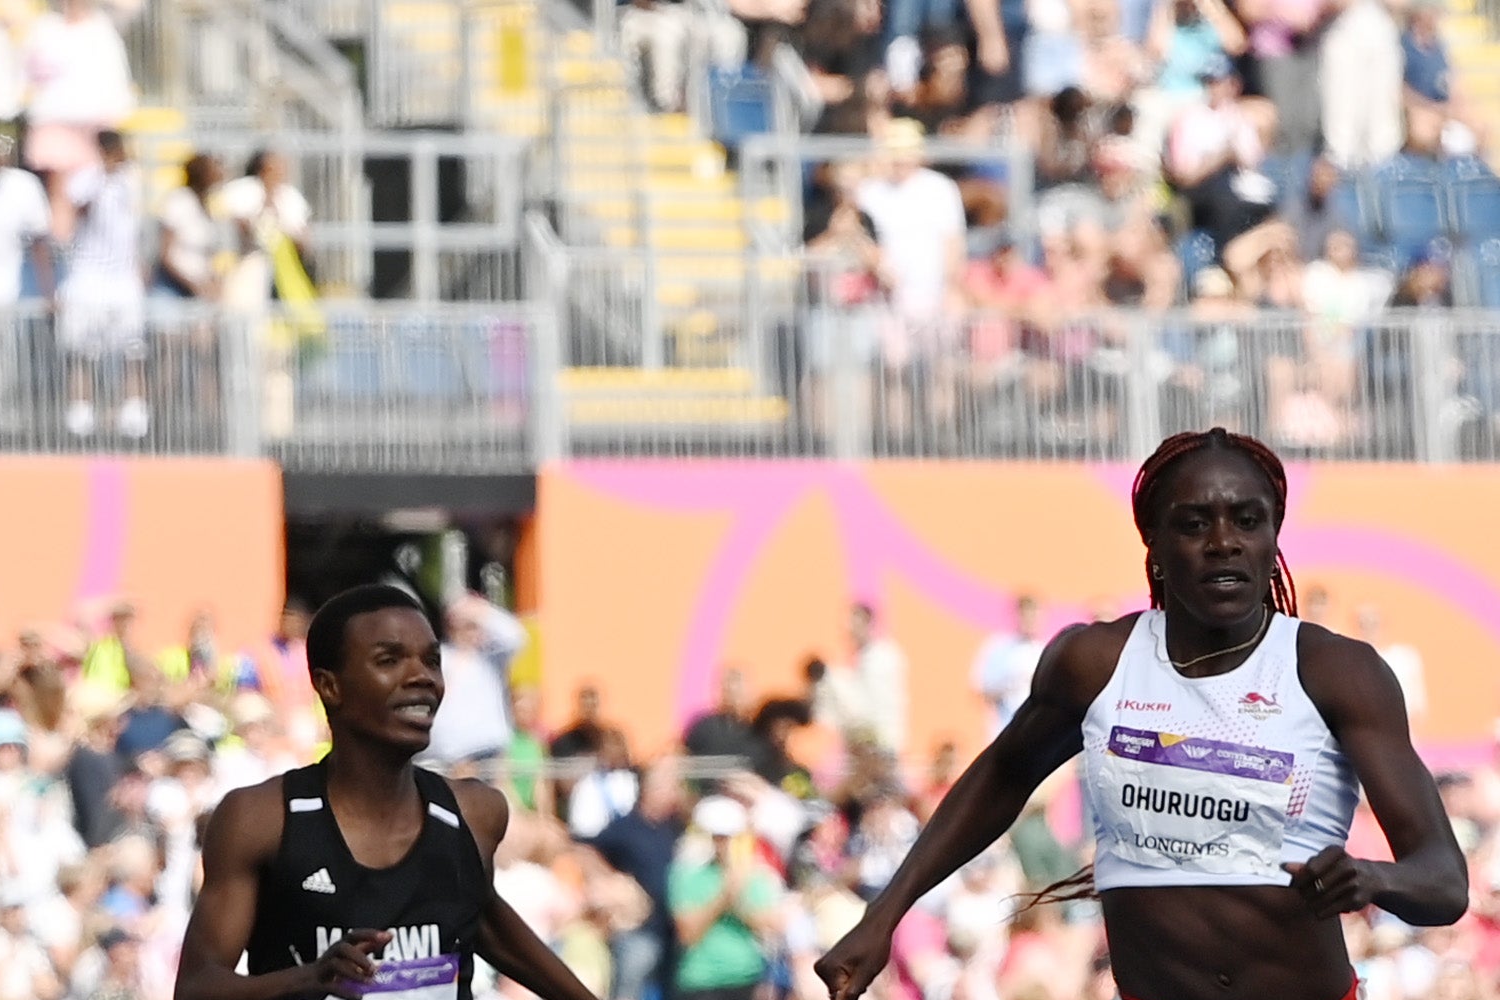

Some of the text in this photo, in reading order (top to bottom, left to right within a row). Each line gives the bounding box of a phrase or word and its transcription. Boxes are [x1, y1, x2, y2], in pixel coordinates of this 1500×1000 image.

[1125, 700, 1172, 712] KUKRI
[1122, 784, 1250, 822] OHURUOGU
[1135, 834, 1230, 857] LONGINES
[316, 924, 440, 961] MAWI
